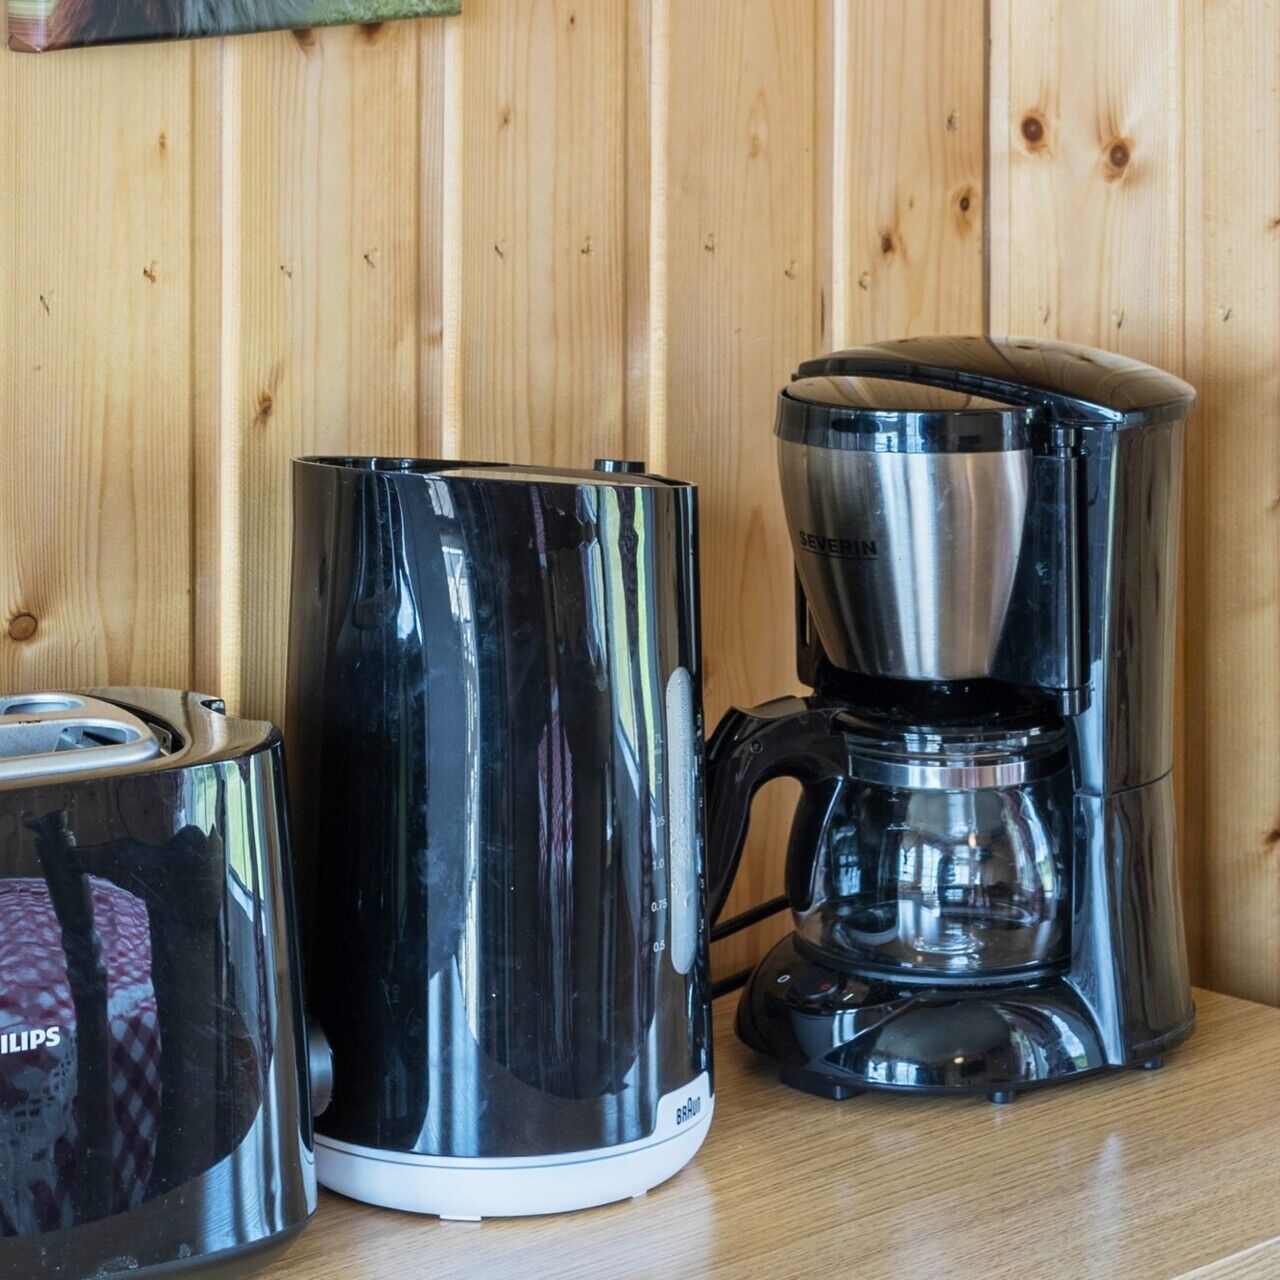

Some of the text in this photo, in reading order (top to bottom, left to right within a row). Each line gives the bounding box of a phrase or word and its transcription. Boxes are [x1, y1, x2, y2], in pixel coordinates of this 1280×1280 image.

[799, 530, 877, 555] SEVERIN
[651, 899, 667, 912] 0.75
[653, 940, 665, 952] 0.5
